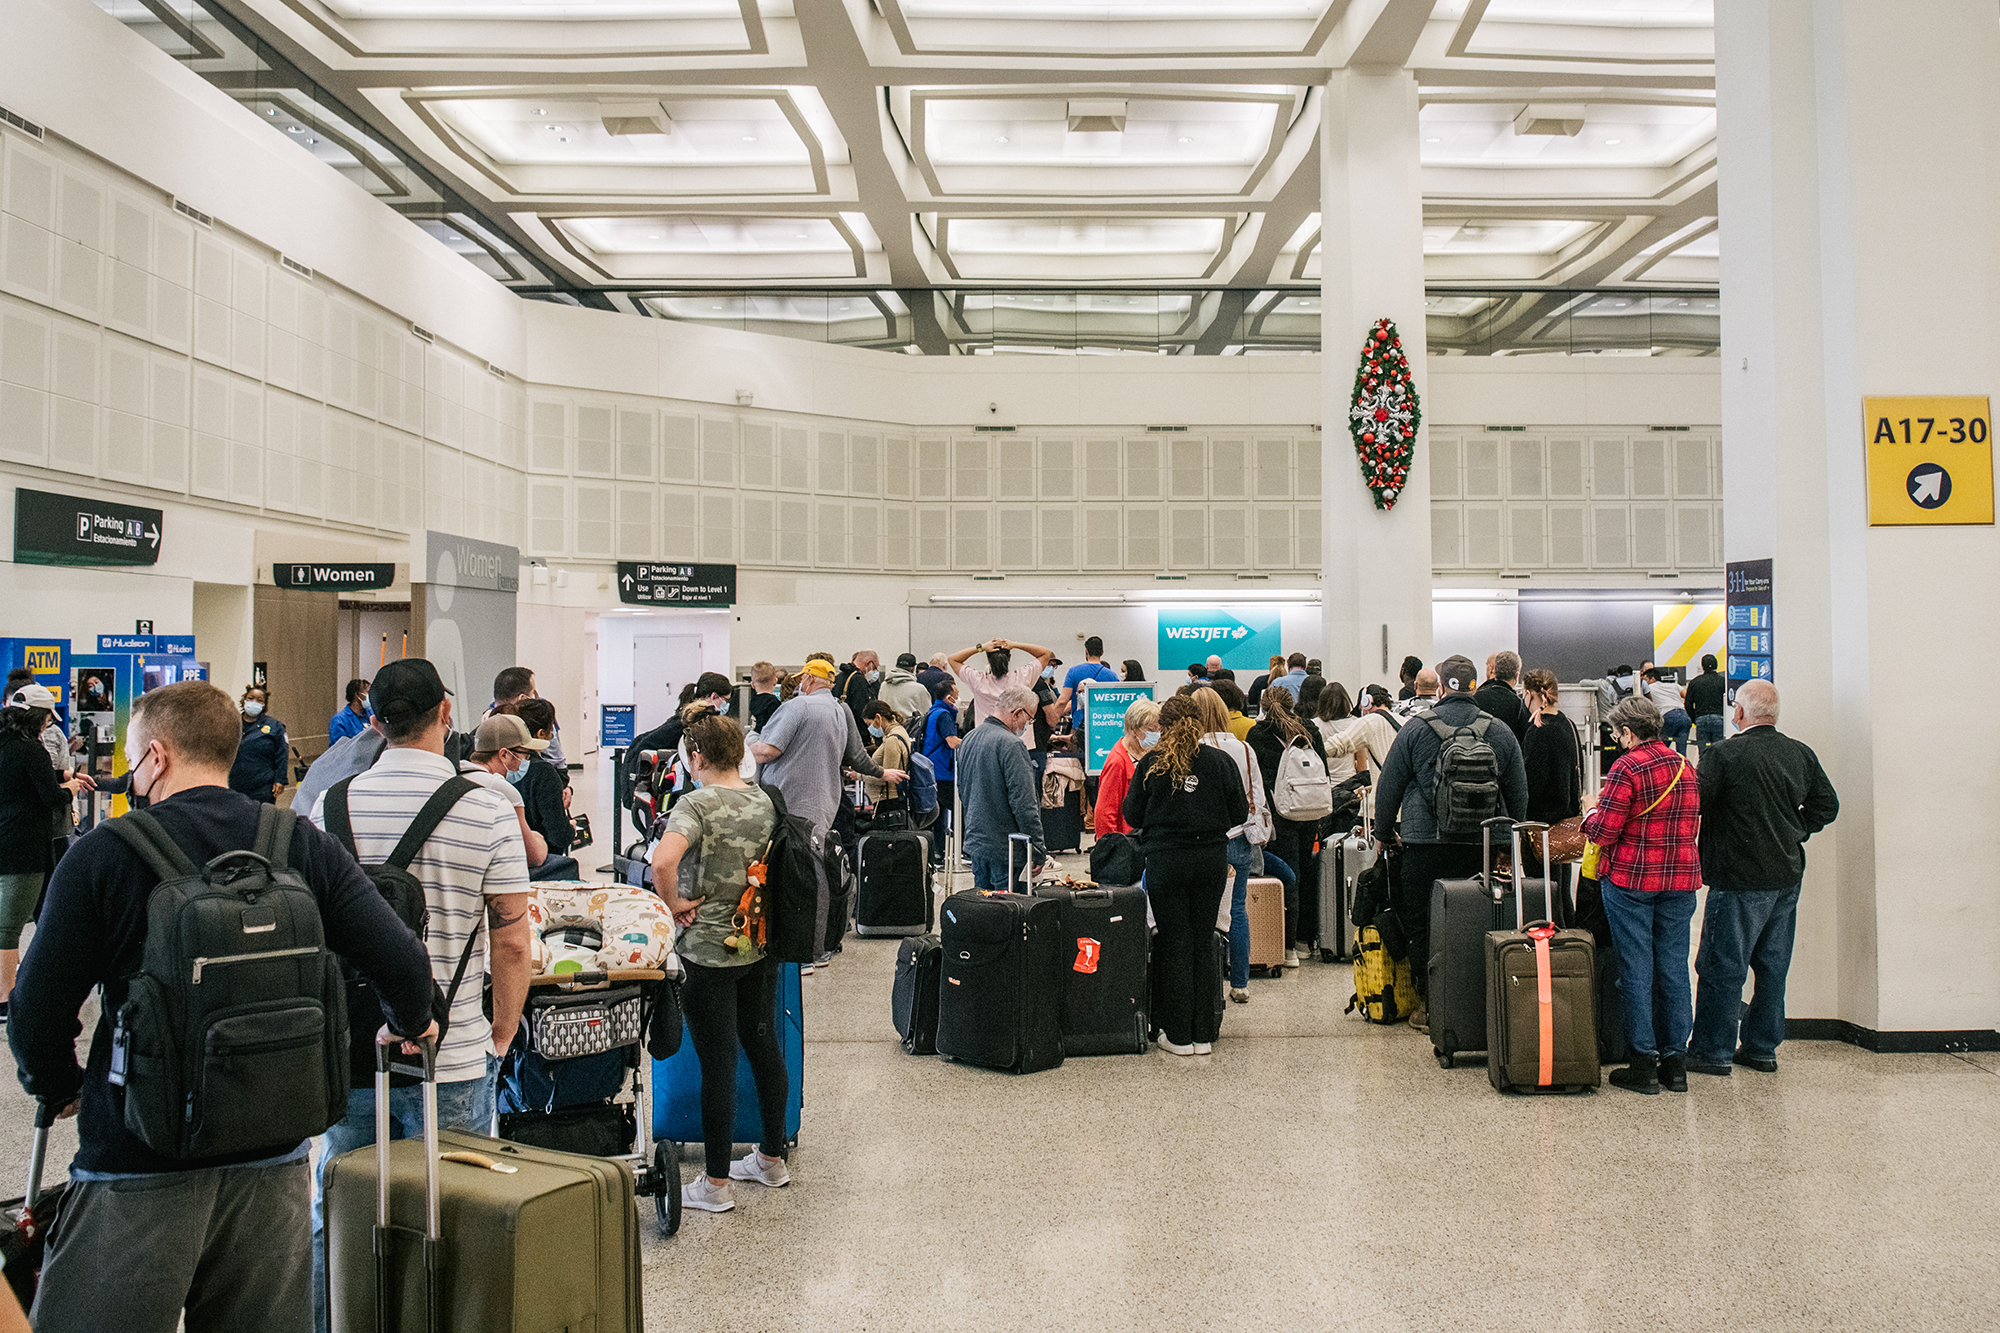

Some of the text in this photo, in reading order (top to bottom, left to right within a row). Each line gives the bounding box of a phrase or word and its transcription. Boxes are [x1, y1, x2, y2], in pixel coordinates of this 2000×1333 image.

[1873, 416, 1987, 444] A17-30
[80, 514, 141, 537] P Parking A B
[93, 533, 137, 547] Estacionamiento
[457, 544, 502, 580] Women
[313, 568, 375, 581] Women
[640, 568, 647, 578] P
[651, 566, 677, 575] Parking
[1166, 627, 1231, 642] WESTJET
[112, 638, 150, 648] Hudson
[172, 644, 193, 653] Hudson
[27, 651, 58, 668] ATM
[183, 669, 200, 681] PPE
[1094, 693, 1136, 703] WESTJET
